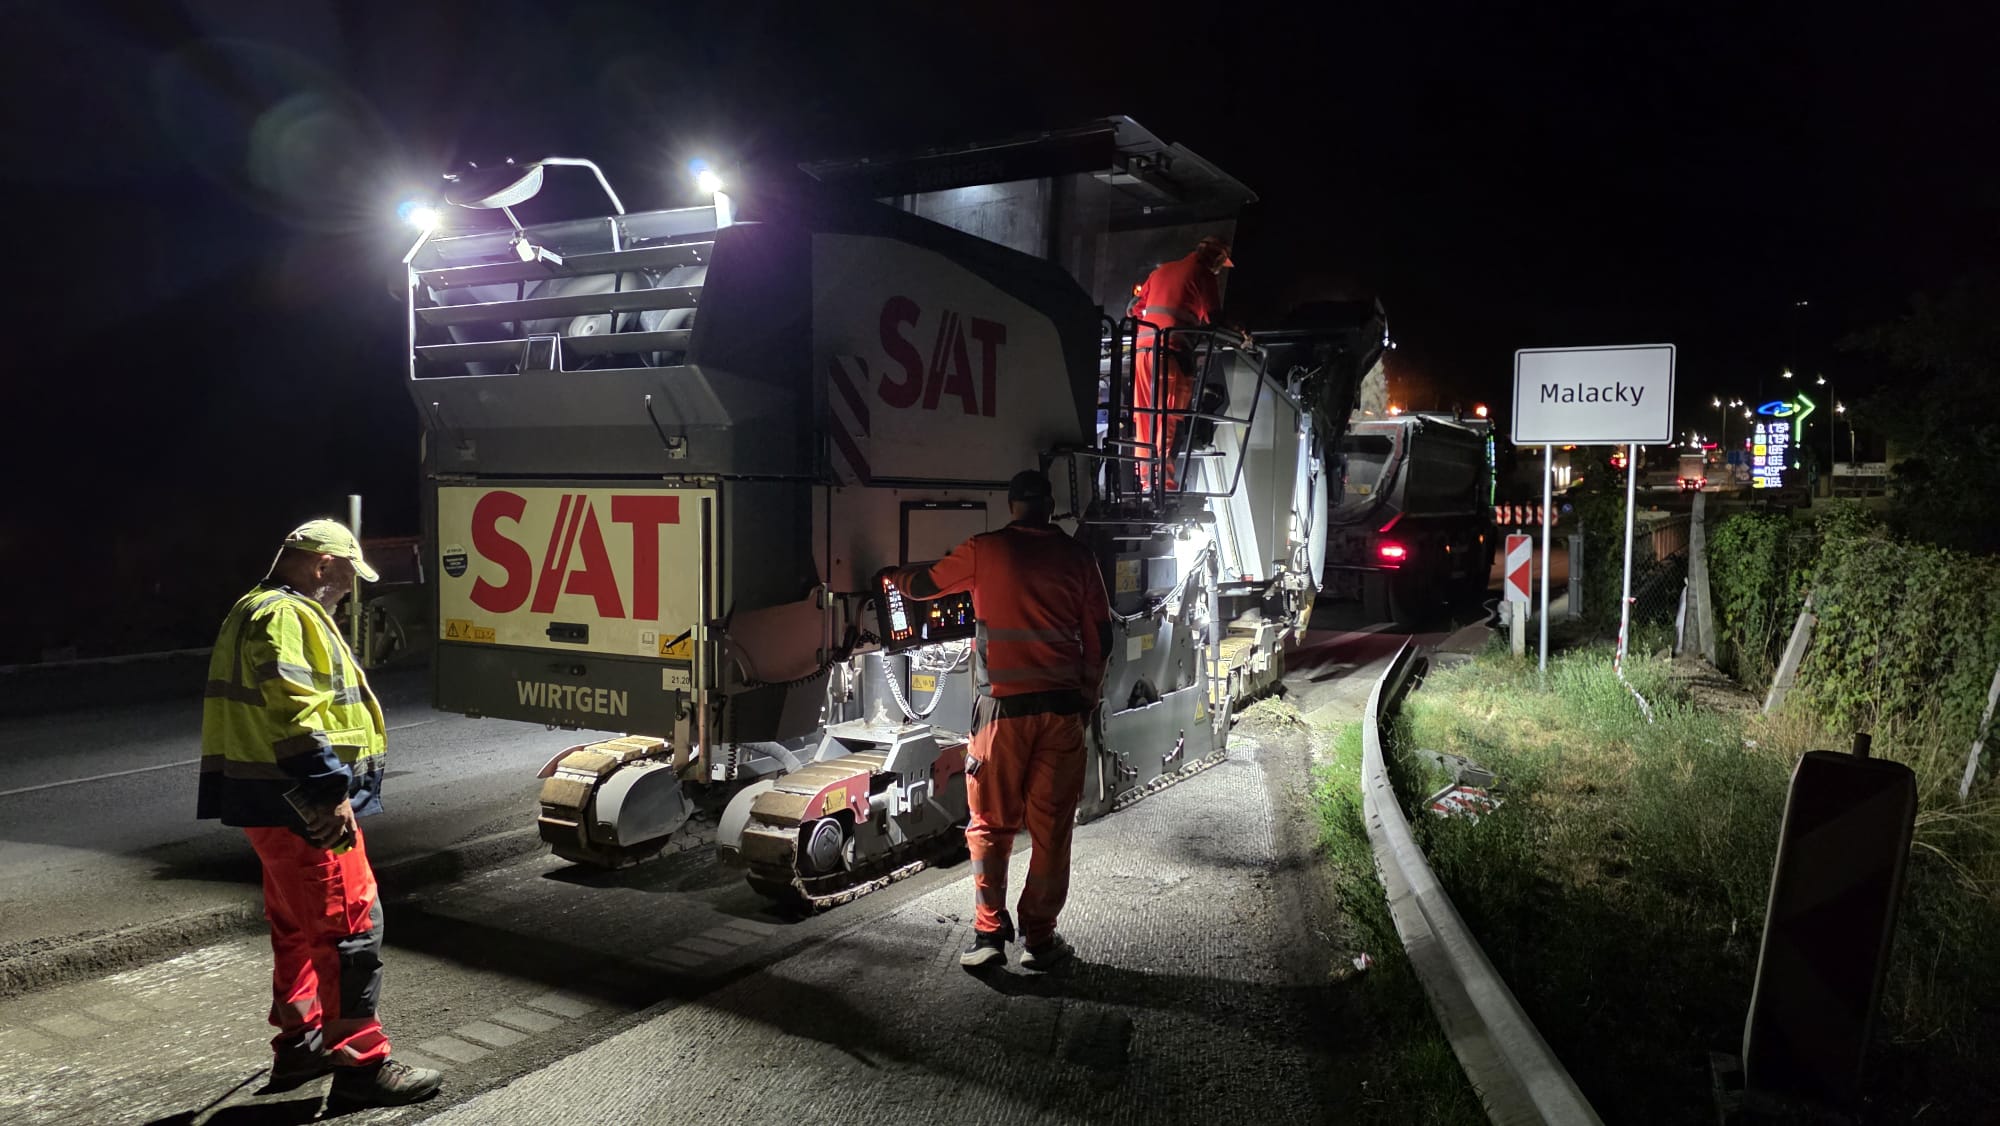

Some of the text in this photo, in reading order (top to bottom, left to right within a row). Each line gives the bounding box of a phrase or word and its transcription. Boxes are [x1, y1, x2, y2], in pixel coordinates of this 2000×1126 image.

[878, 295, 1006, 417] SAT
[1540, 381, 1645, 406] Malacky
[469, 490, 680, 621] SAT
[517, 680, 628, 717] WIRTGEN
